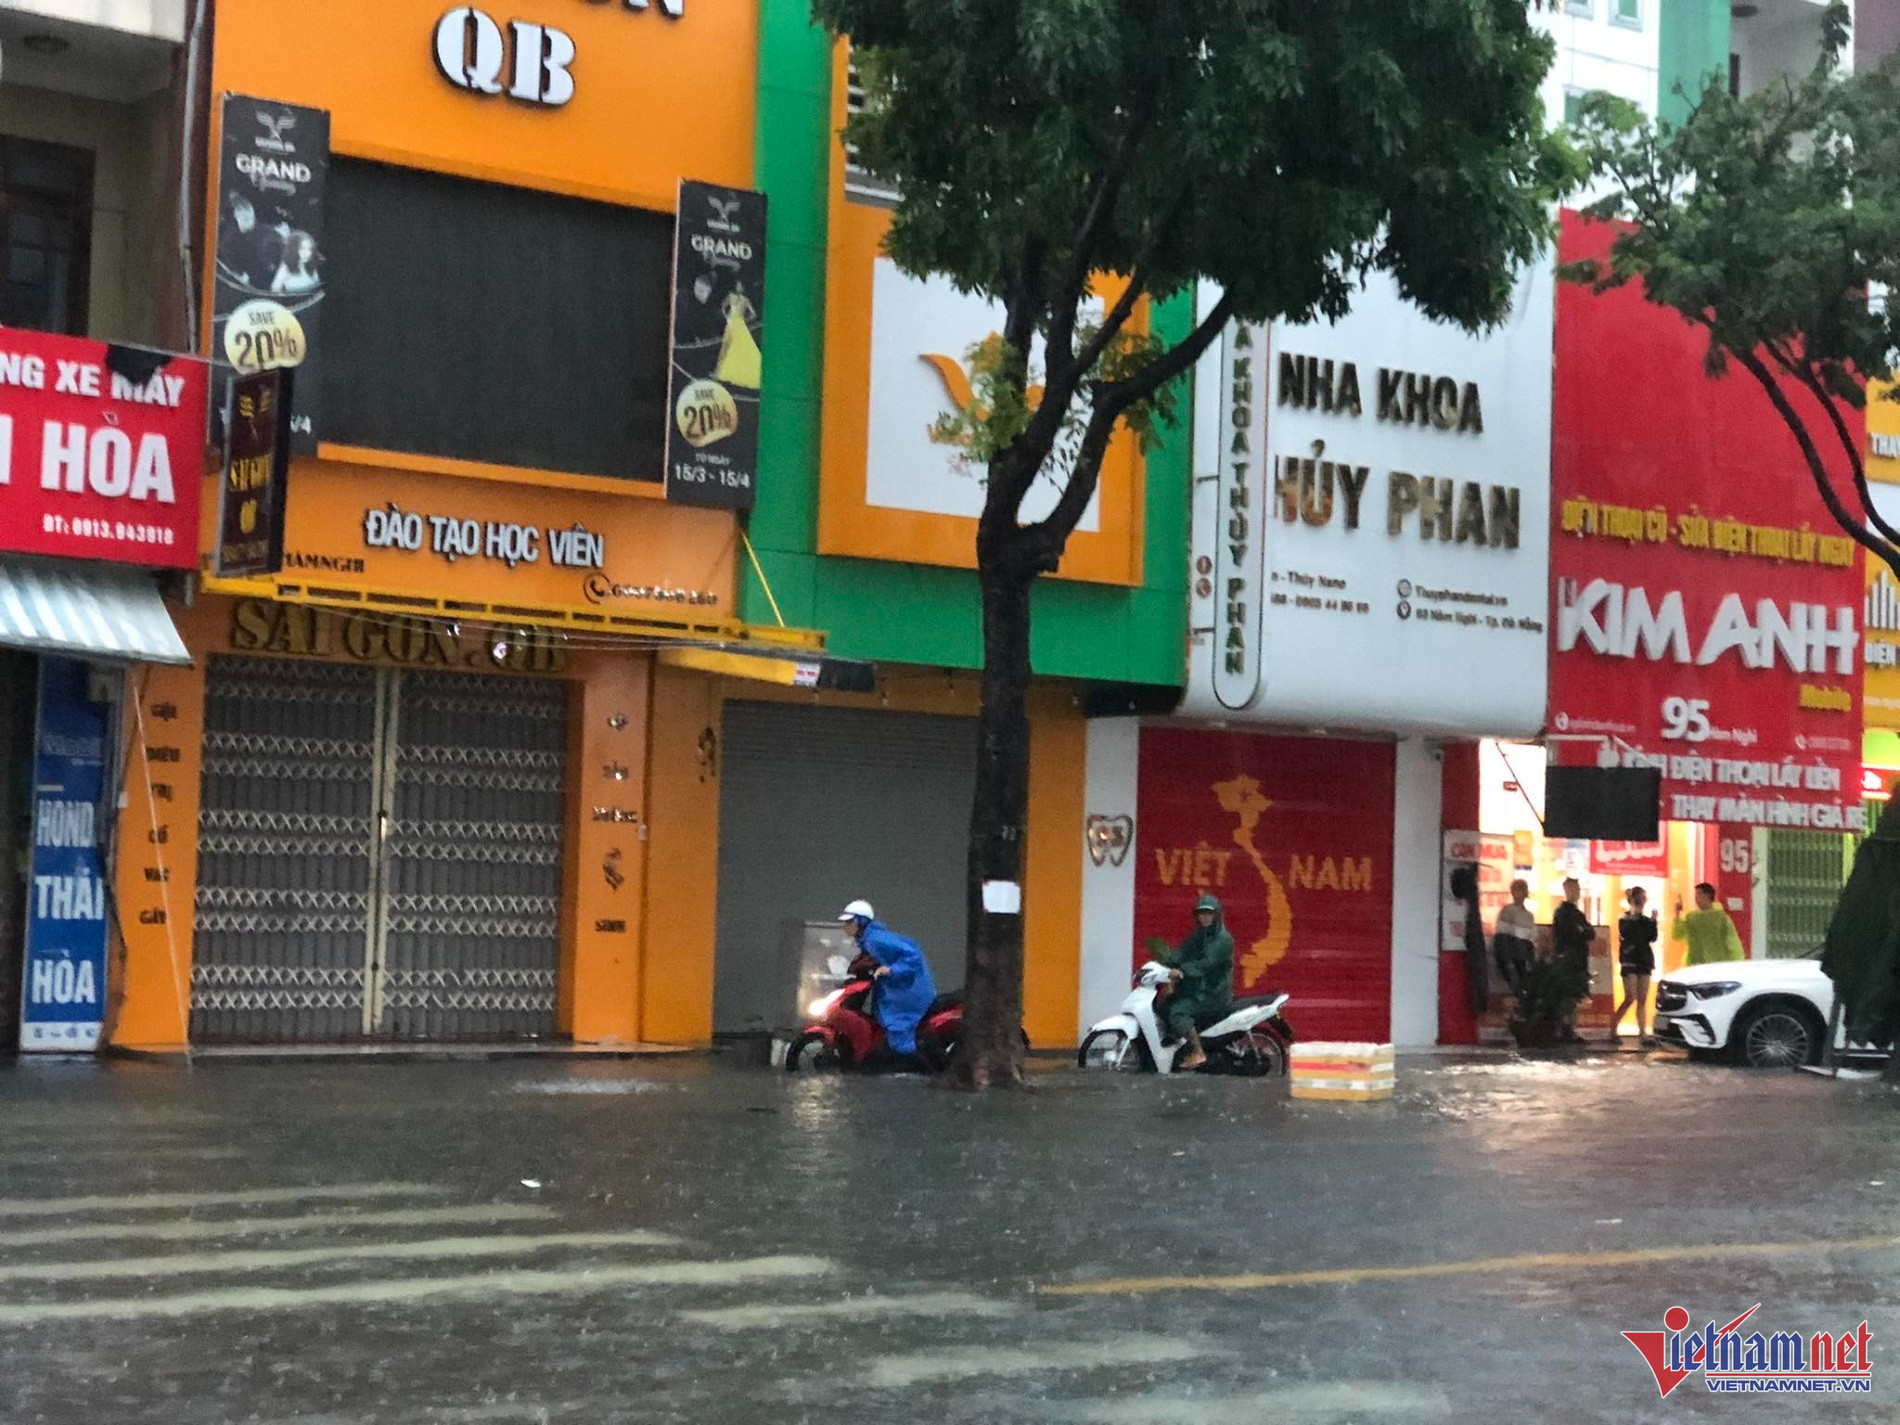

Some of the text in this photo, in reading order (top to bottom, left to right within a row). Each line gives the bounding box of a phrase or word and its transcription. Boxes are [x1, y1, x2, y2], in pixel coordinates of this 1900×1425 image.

[433, 6, 576, 108] QB
[236, 153, 311, 183] GRAND
[691, 234, 753, 260] GRAND
[248, 309, 275, 326] SAVE
[234, 329, 298, 371] 20%
[55, 359, 100, 397] XE
[1278, 352, 1484, 434] NHA KHOA
[683, 403, 732, 438] 20%
[41, 410, 176, 504] HÒA
[675, 463, 706, 484] 15/3
[1388, 471, 1521, 549] PHAN
[365, 504, 604, 568] ĐÀO TẠO HỌC VIÊN
[1557, 577, 1860, 675] KIM ANH
[1660, 696, 1711, 742] 95
[1289, 853, 1373, 891] NAM
[1720, 838, 1750, 873] 95
[31, 949, 96, 1004] HÒA
